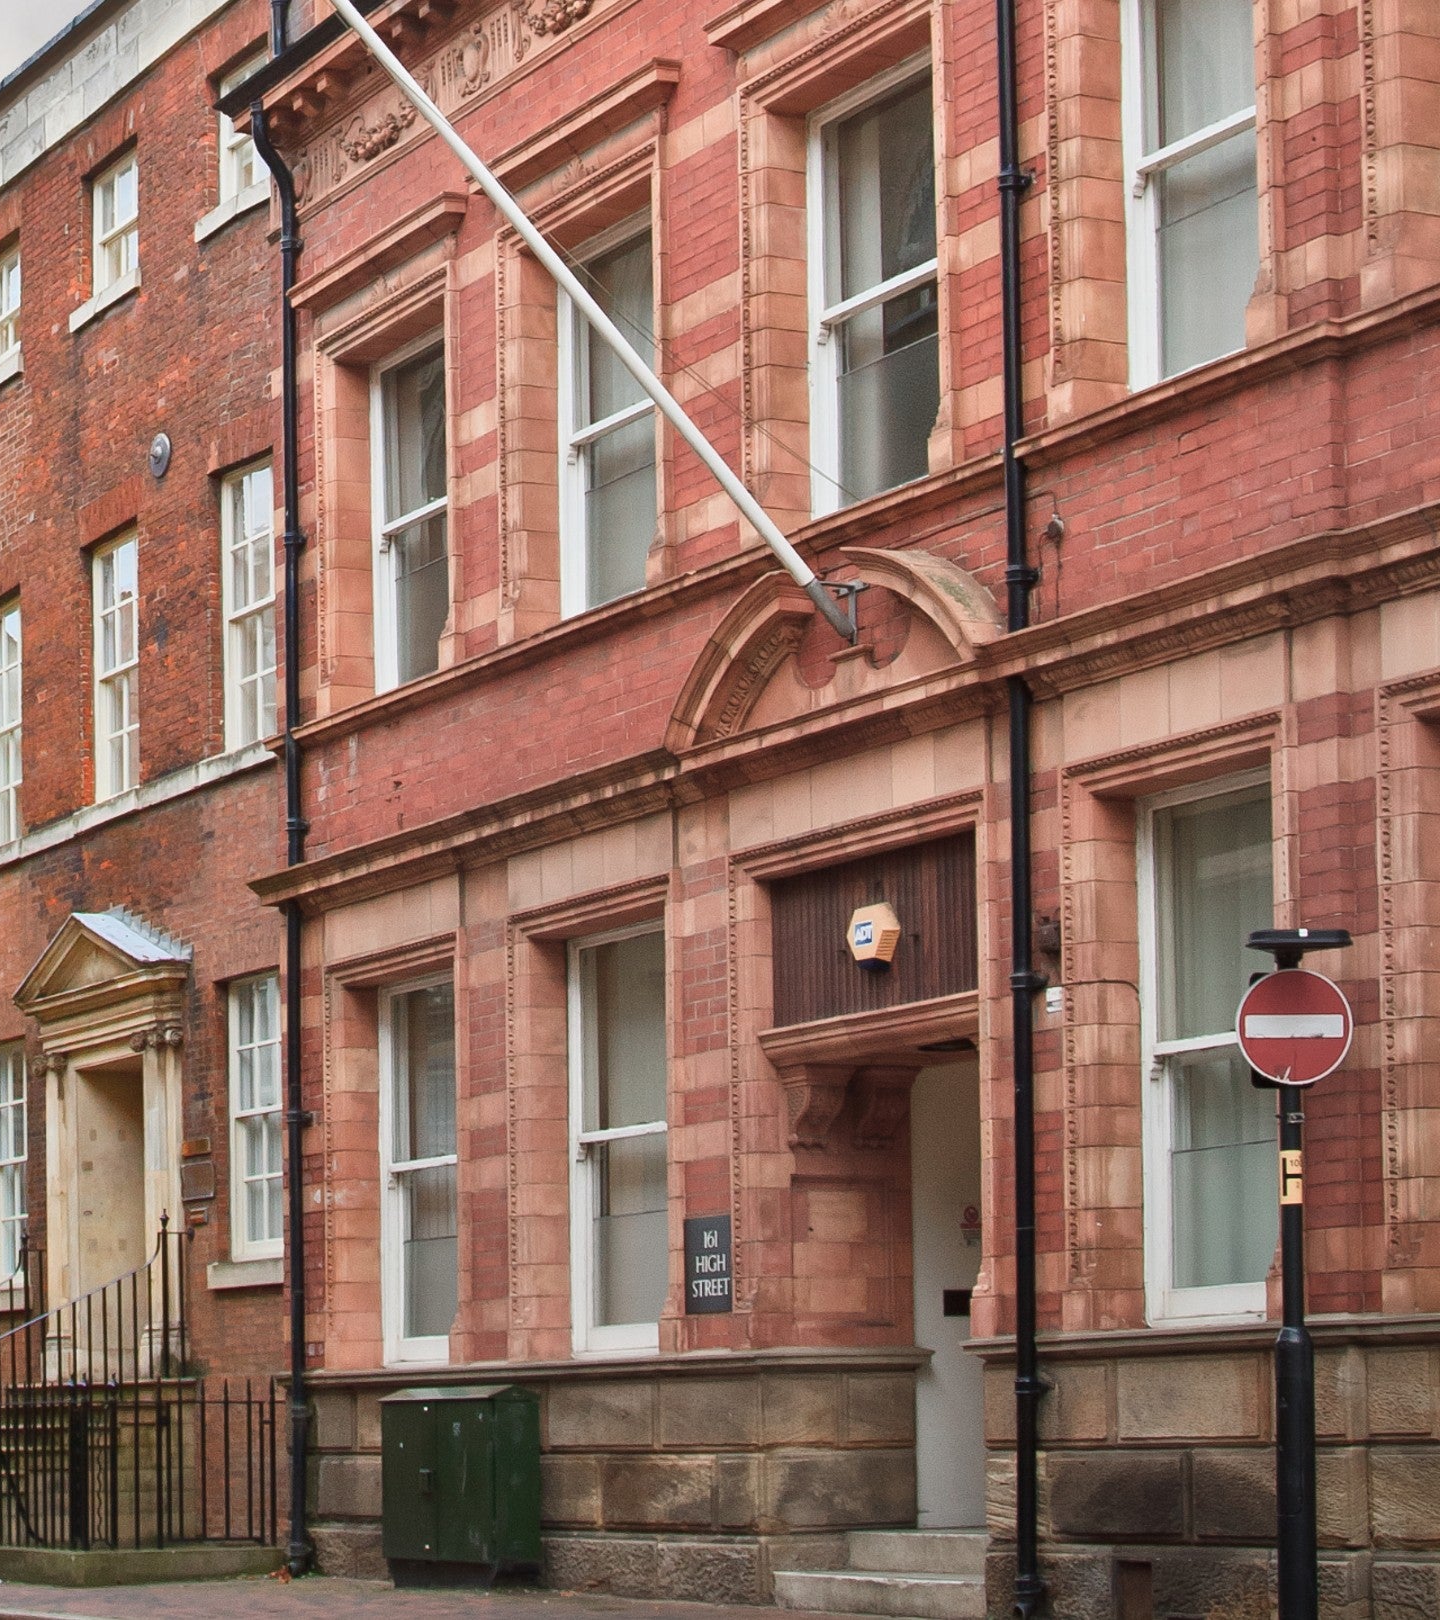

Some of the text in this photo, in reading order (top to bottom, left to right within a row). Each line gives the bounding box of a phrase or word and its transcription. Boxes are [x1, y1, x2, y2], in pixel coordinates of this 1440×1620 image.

[855, 925, 873, 942] ADT
[703, 1230, 718, 1249] 161
[695, 1253, 726, 1273] HIGH
[692, 1277, 730, 1298] STREET
